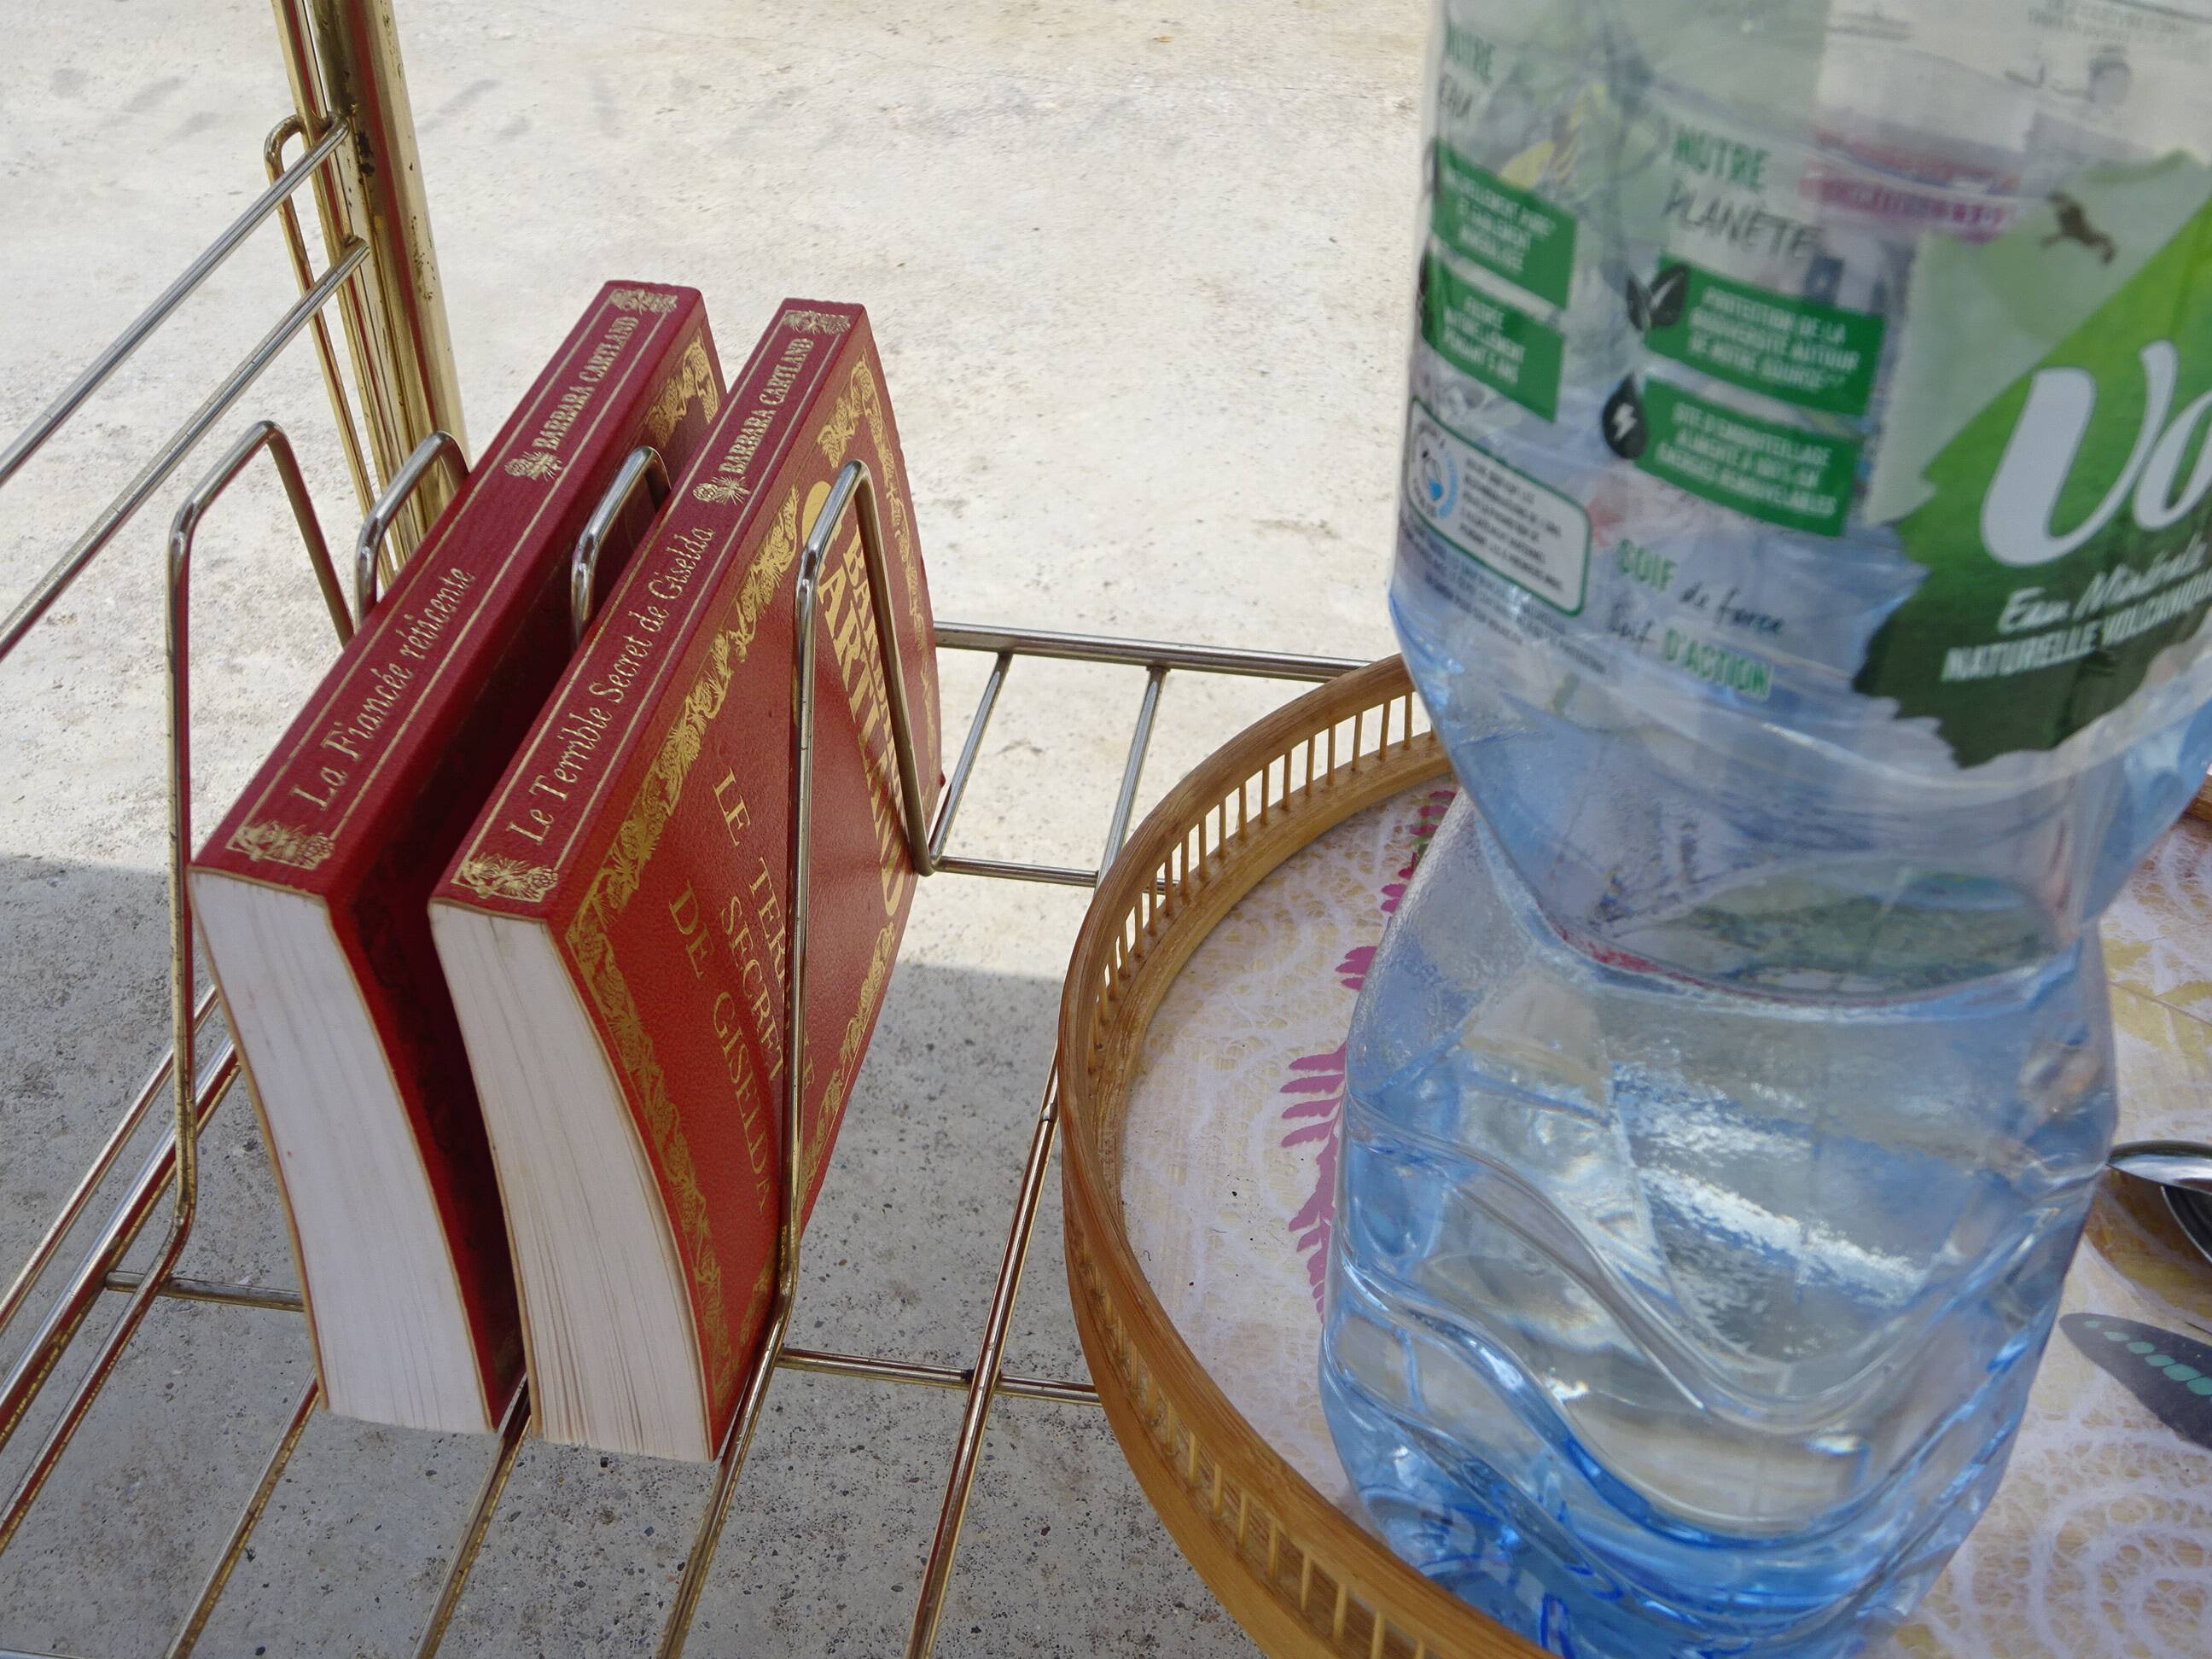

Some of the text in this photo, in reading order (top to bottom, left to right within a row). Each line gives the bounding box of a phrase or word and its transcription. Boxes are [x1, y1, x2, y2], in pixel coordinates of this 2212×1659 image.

[531, 315, 639, 451] BARBARA CARTLAND
[719, 336, 814, 476] BARBARA CARTLAND
[1941, 619, 2104, 683] NATURELLE
[1998, 586, 2071, 636] Eau
[291, 566, 477, 812] La Fiancée réticente
[505, 526, 717, 847] Le Terrible Secret de Giselda
[713, 766, 751, 847] LE
[669, 880, 770, 1214] DE GISELDA
[719, 895, 783, 1080] SECRET
